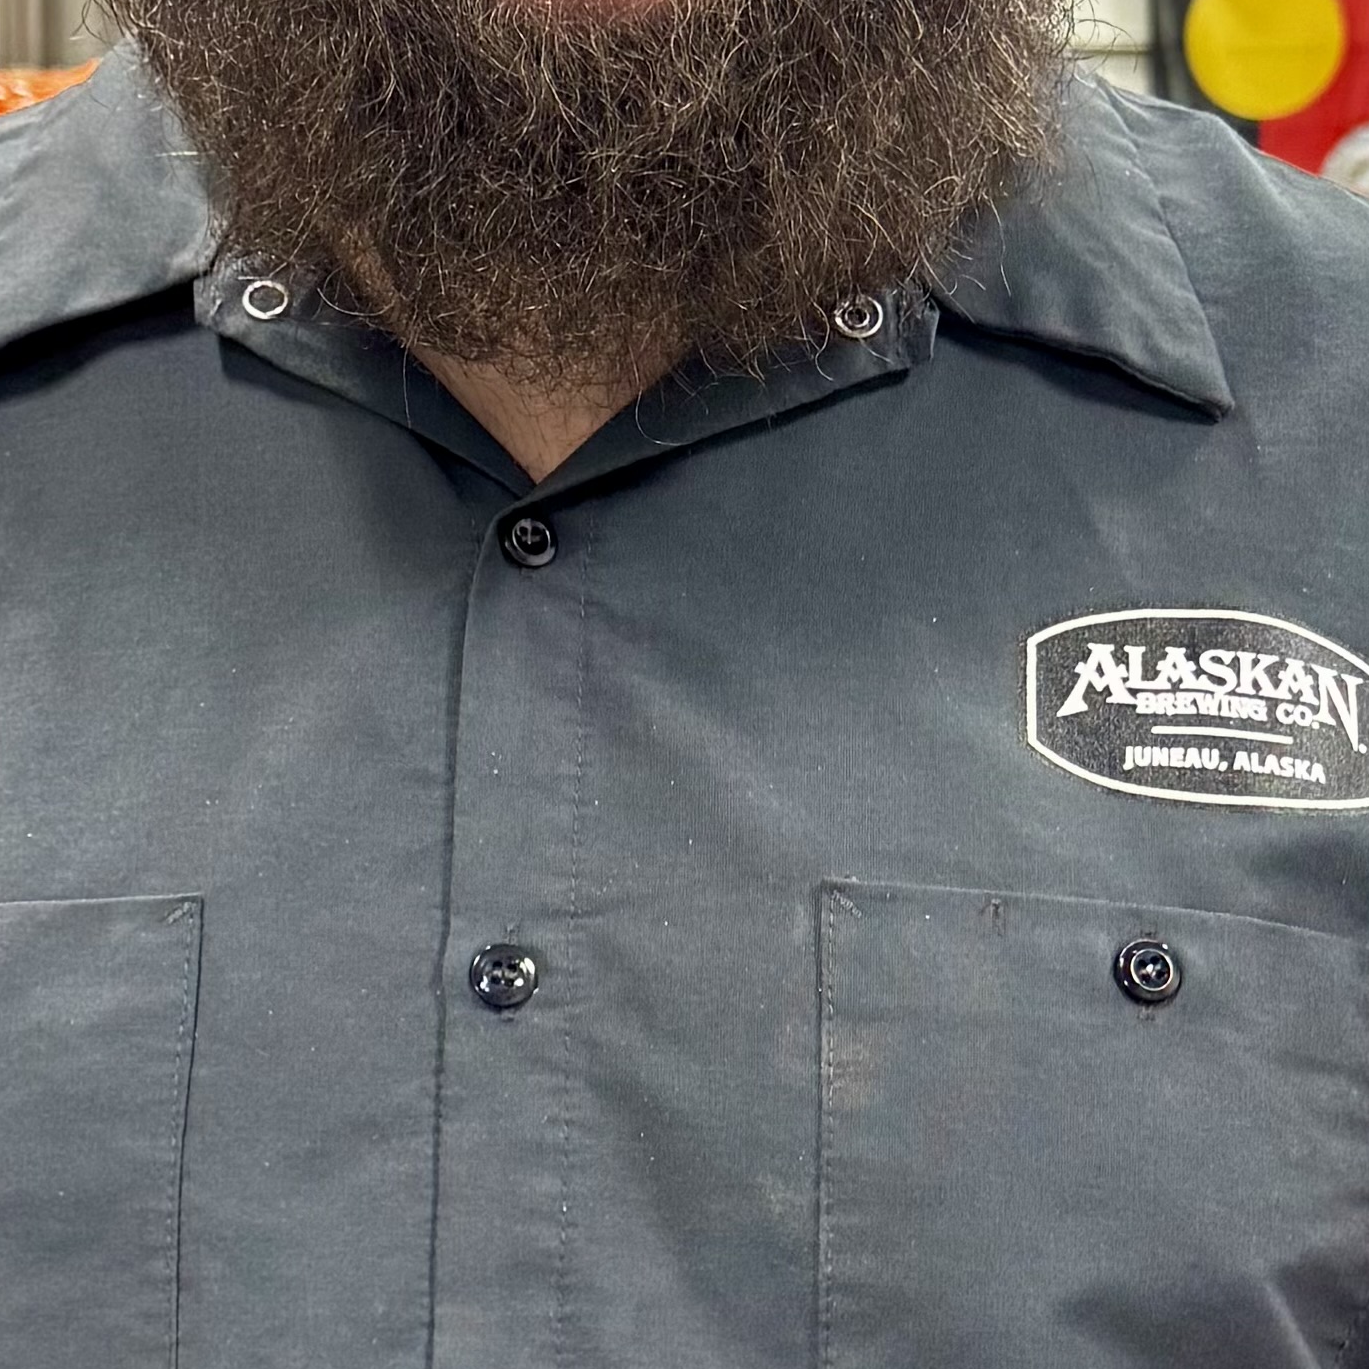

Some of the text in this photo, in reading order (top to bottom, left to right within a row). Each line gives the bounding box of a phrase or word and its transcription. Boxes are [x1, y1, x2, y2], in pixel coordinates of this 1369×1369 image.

[1057, 642, 1364, 752] ALASKAN
[1136, 691, 1320, 729] BREWING CO.
[1123, 745, 1326, 784] JUNEAU, ALASKA
